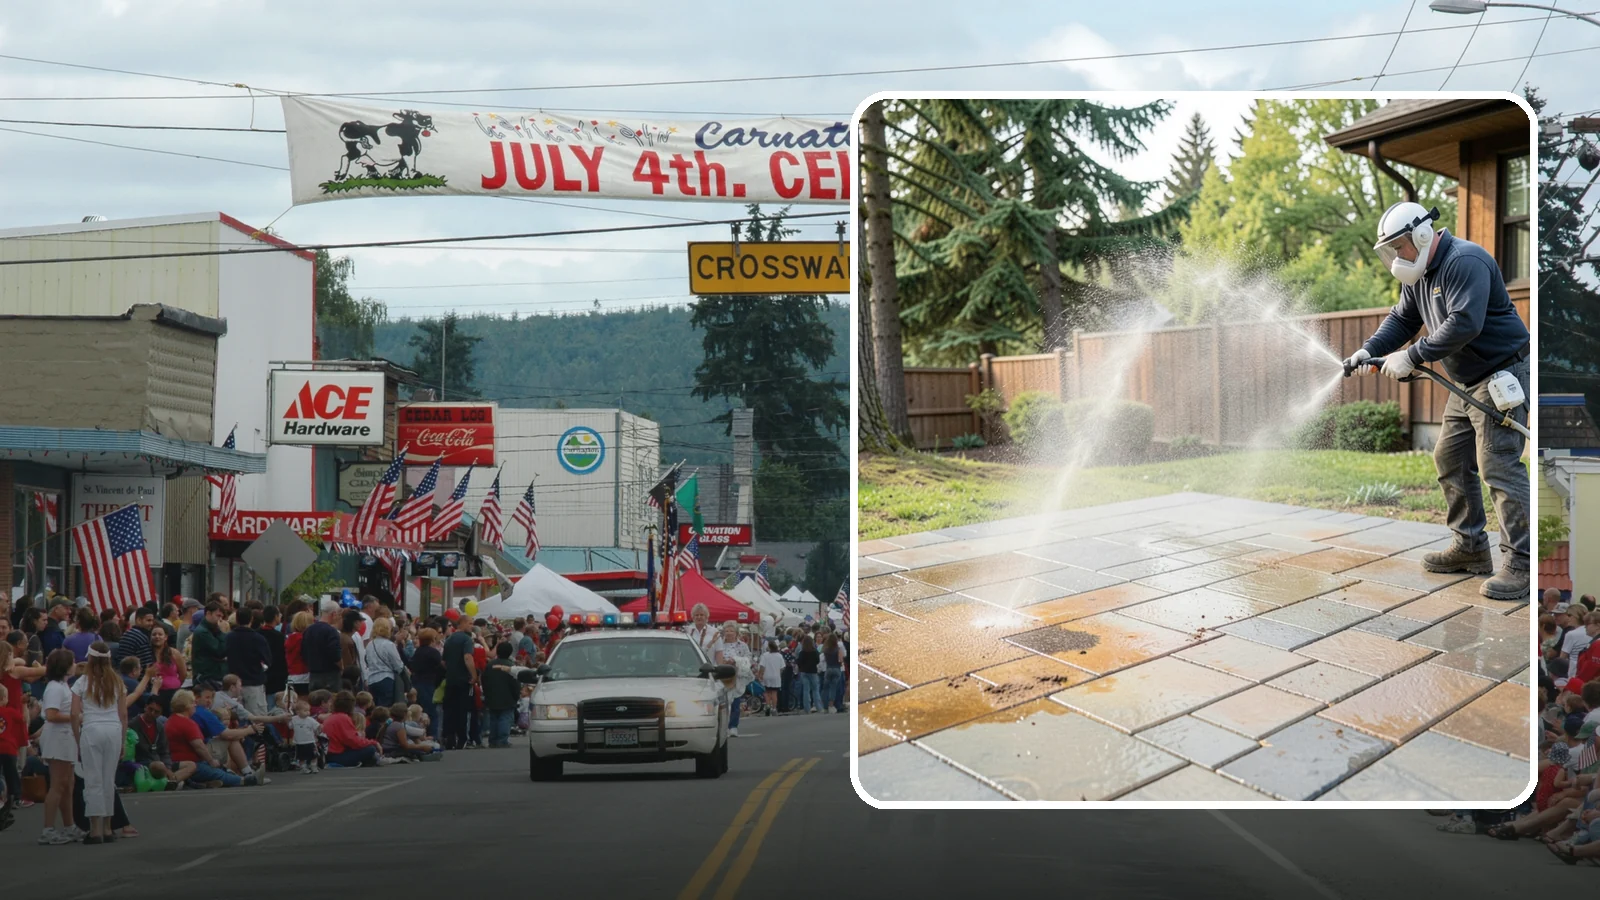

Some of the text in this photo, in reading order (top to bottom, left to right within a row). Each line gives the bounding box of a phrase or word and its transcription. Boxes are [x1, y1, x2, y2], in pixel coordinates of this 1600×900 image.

[481, 141, 604, 192] JULY
[632, 150, 746, 198] 4th.
[696, 254, 850, 280] CROSSWA
[282, 380, 373, 420] ACE
[405, 409, 452, 421] CEDAR
[283, 420, 371, 436] Hardware
[416, 428, 477, 447] Coca-Cola
[353, 467, 387, 479] Simpl
[95, 485, 124, 495] Vincent
[126, 486, 136, 495] de
[138, 486, 155, 495] Paul
[688, 526, 741, 535] CRNATION
[698, 535, 730, 543] GLASS
